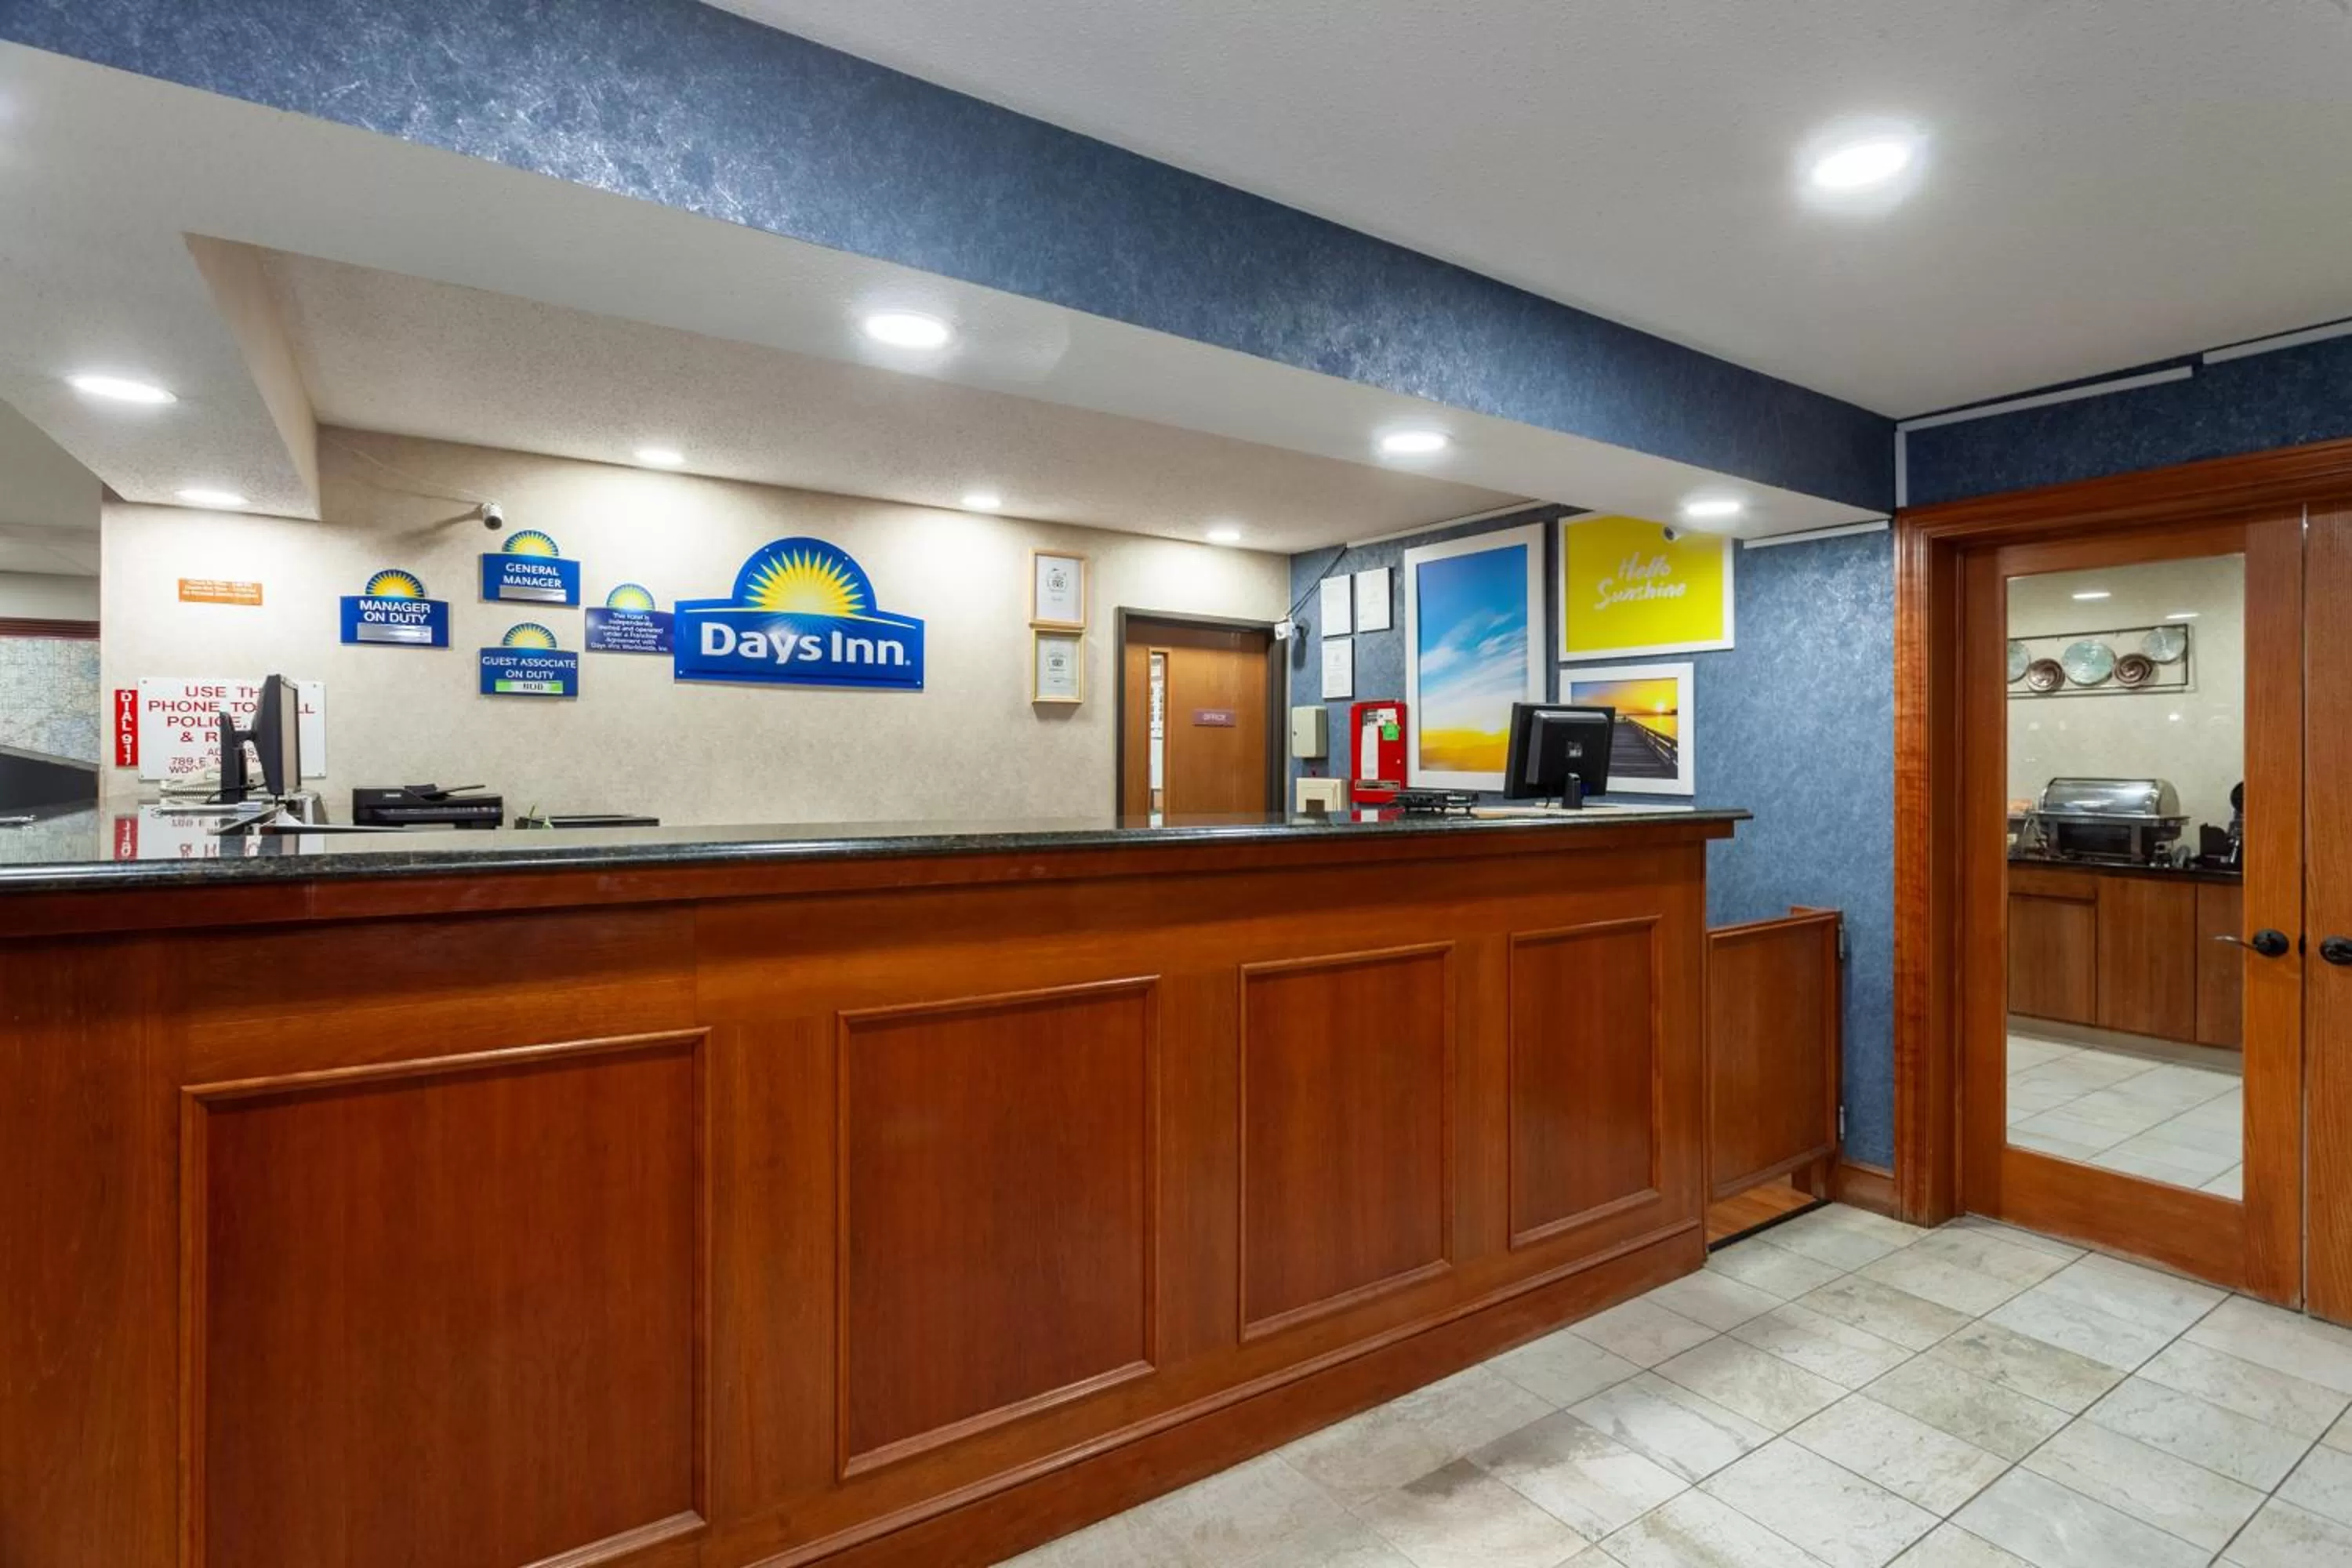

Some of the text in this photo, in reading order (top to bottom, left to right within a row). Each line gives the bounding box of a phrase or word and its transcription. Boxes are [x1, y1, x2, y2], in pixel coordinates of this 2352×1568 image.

[506, 563, 560, 576] GENERAL
[1618, 552, 1671, 581] Hello
[503, 575, 562, 588] MANAGER
[1593, 577, 1686, 610] Sunshine
[359, 600, 431, 613] MANAGER
[364, 612, 426, 624] ON DUTY
[701, 622, 822, 664] Days
[482, 656, 577, 669] GUEST ASSOCIATE
[505, 670, 555, 679] ON DUTY
[185, 686, 227, 698] USE
[120, 692, 132, 731] DIAL
[148, 700, 220, 713] PHONE
[230, 702, 257, 713] TO
[180, 732, 194, 742] &
[122, 733, 132, 765] 911
[170, 757, 194, 766] 789
